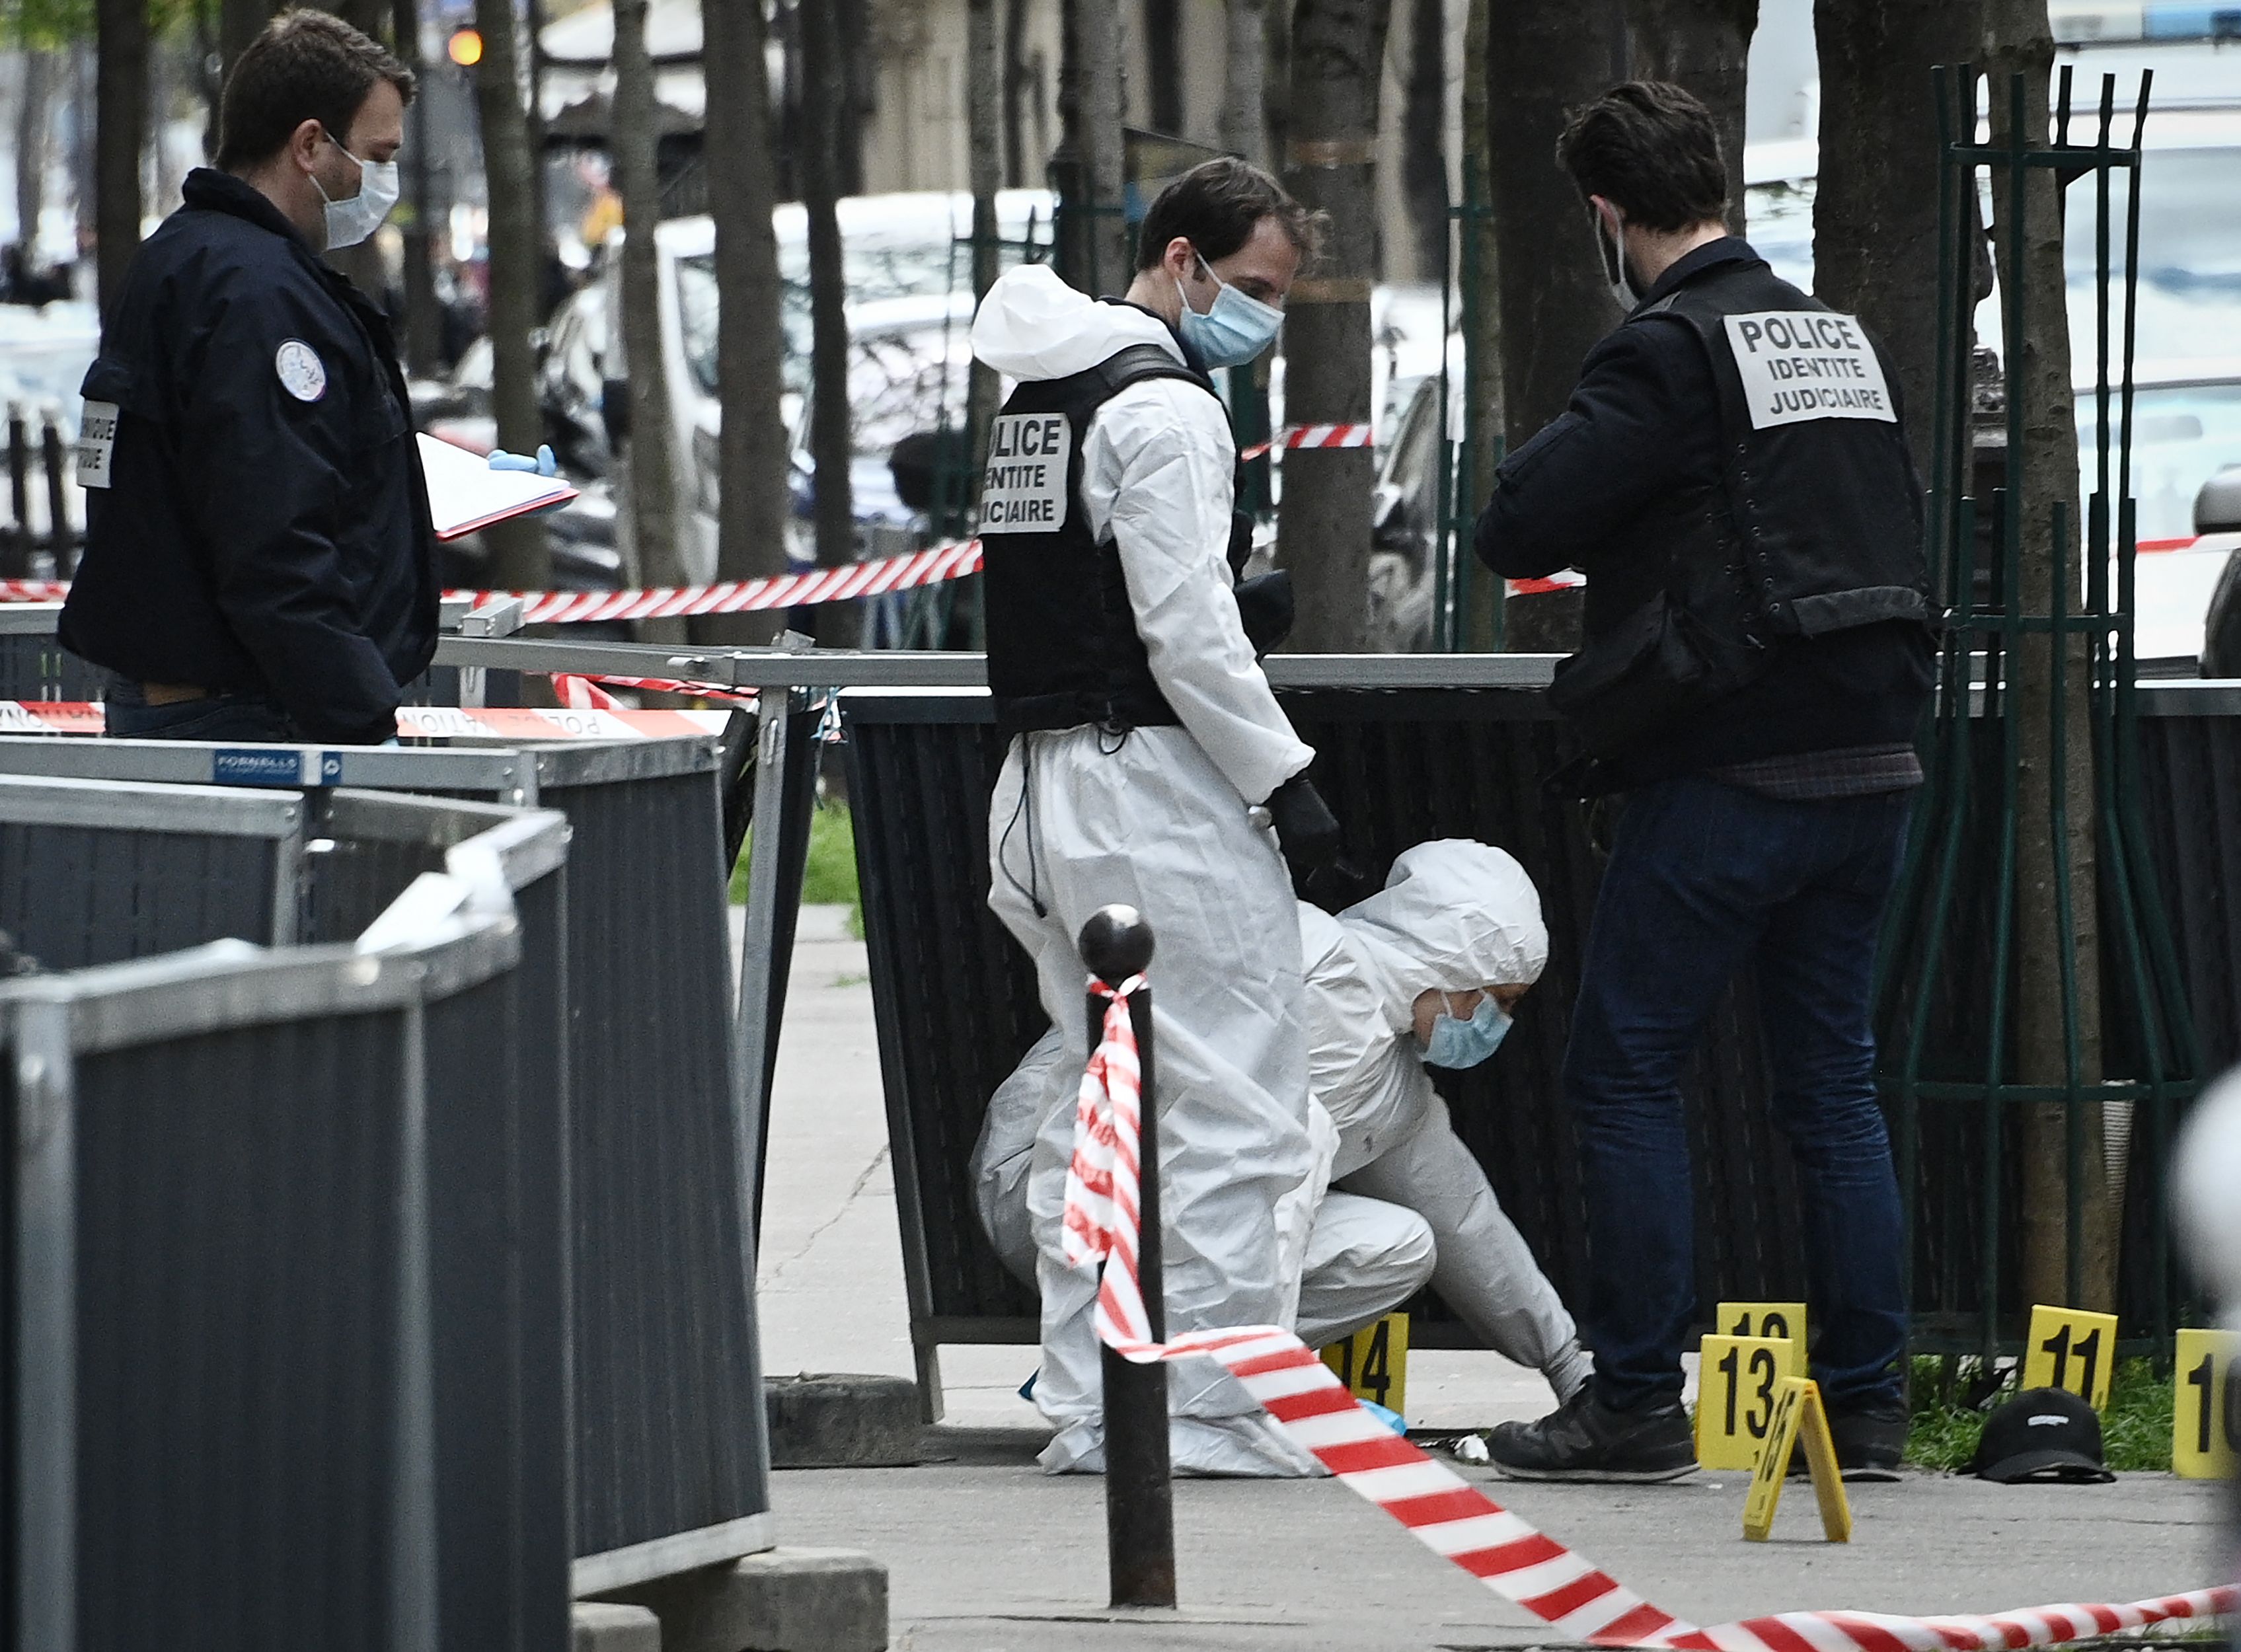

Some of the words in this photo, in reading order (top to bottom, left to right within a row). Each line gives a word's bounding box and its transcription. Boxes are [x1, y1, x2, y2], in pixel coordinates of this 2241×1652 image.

[1738, 317, 1861, 353] POLICE
[1767, 357, 1866, 381] IDENTITE
[1770, 387, 1884, 414] JUDICIAIRE
[991, 420, 1062, 457] LICE
[2041, 1324, 2102, 1402] 11
[1718, 1346, 1776, 1439] 13
